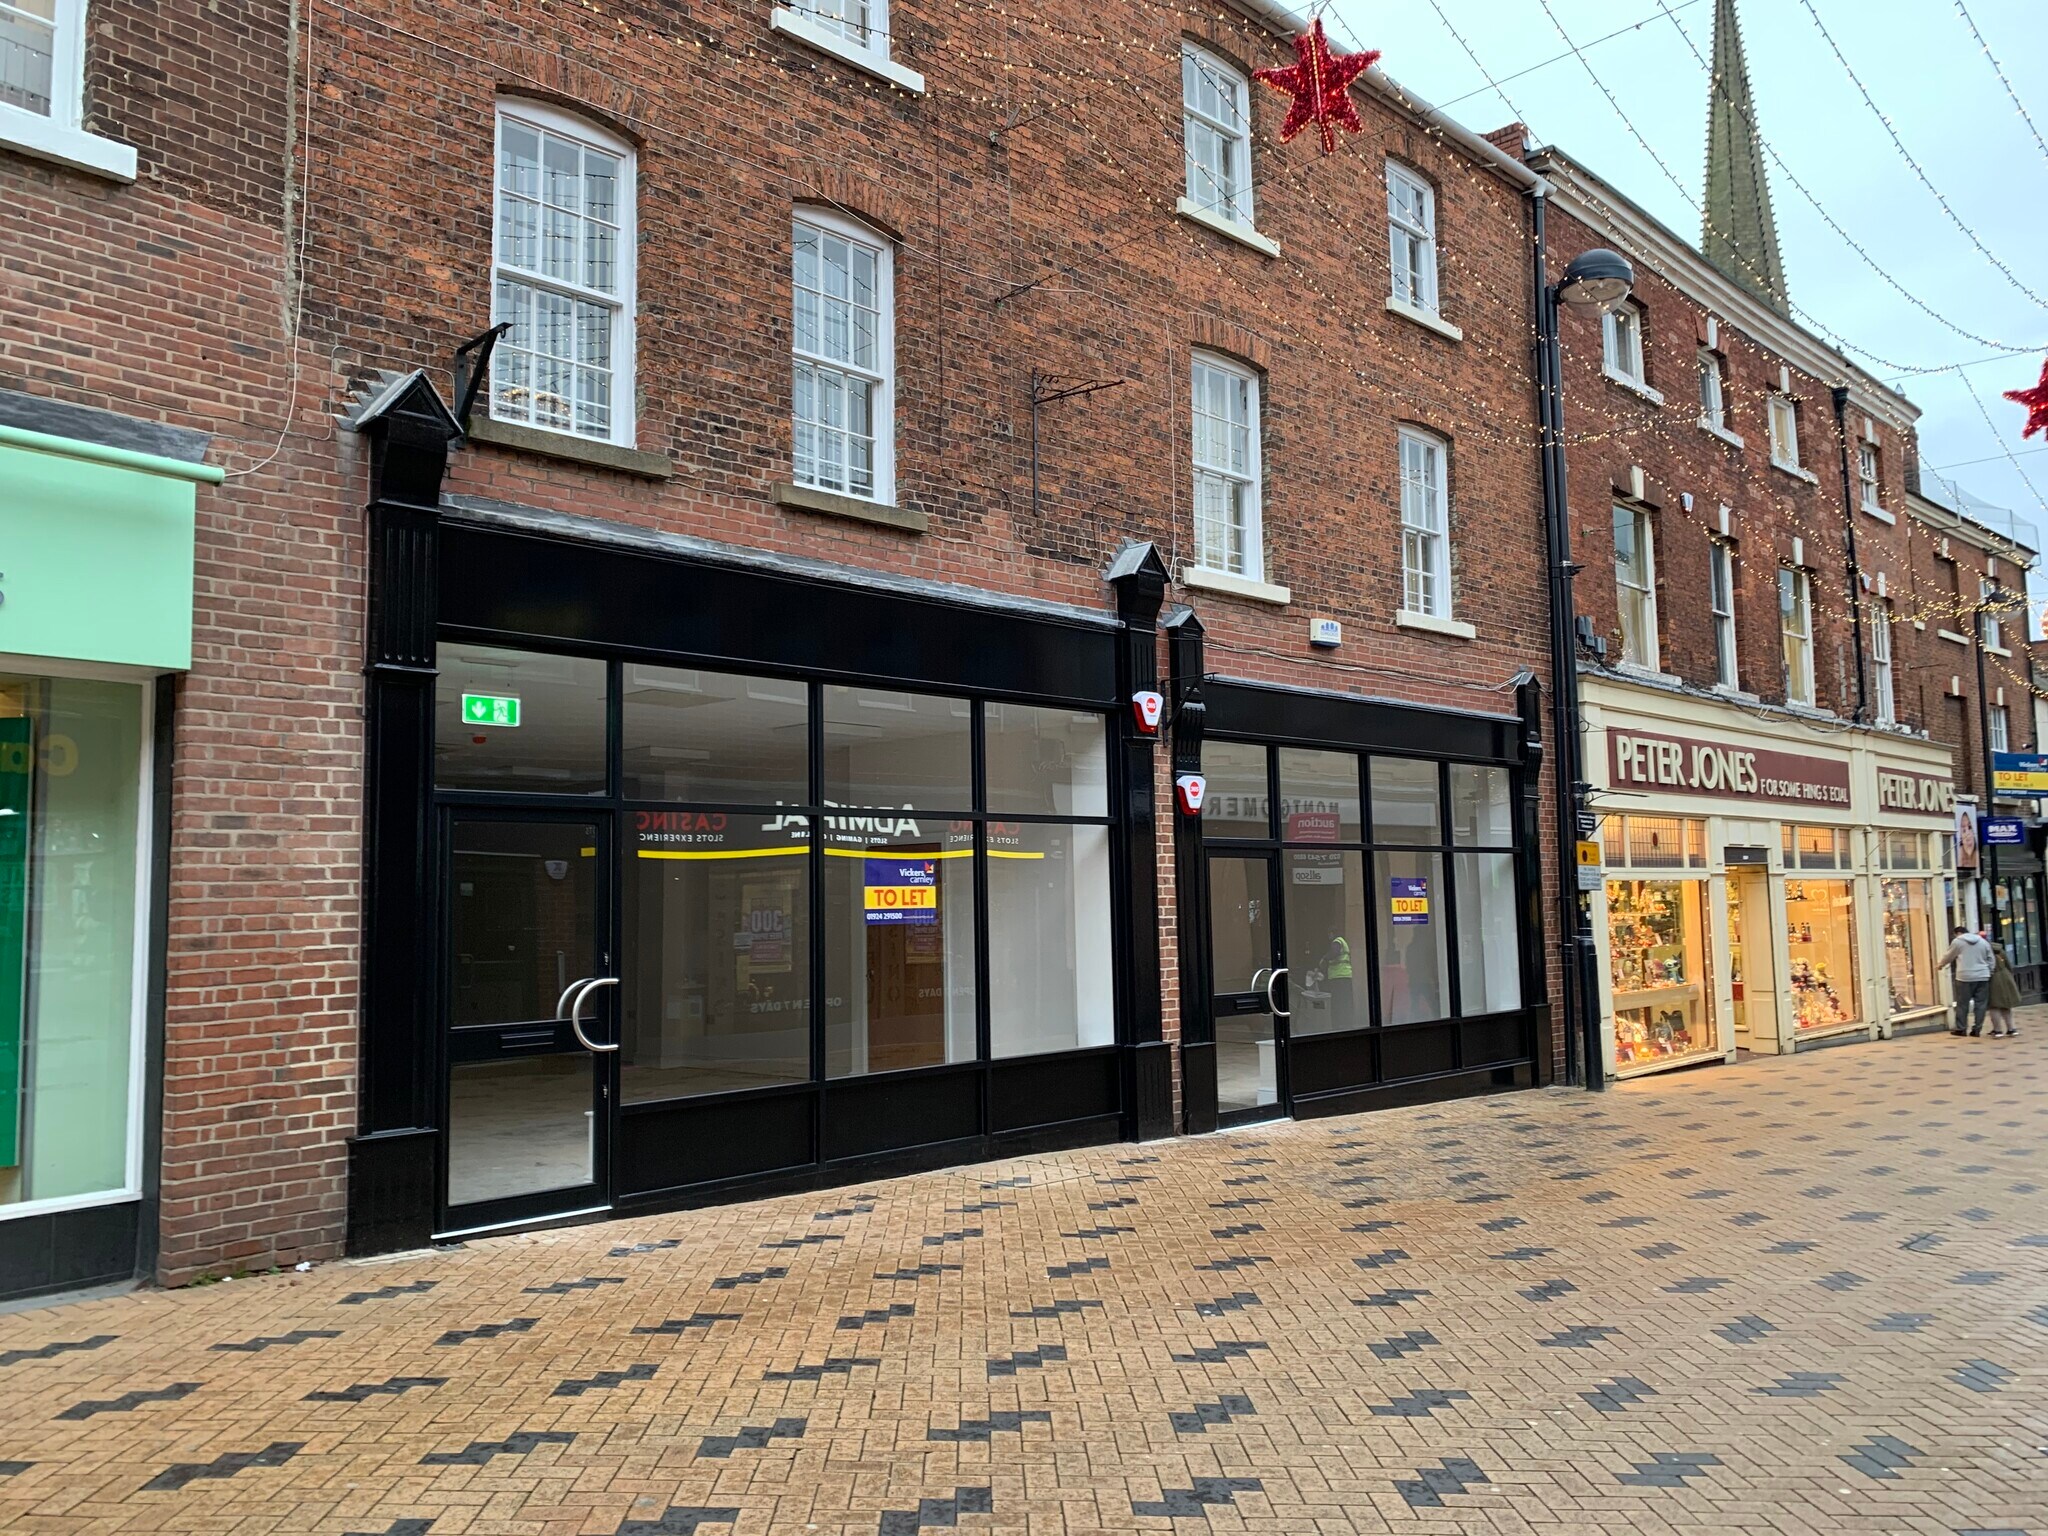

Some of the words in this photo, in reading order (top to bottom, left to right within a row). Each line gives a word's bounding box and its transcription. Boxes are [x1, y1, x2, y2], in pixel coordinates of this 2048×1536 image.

[1615, 734, 1686, 786] PETER
[1689, 745, 1758, 794] JONES
[1998, 772, 2011, 781] TO
[2014, 772, 2028, 782] LET
[1760, 778, 1779, 796] FOR
[1879, 772, 1918, 809] PETER
[1918, 778, 1956, 813] JONES
[1987, 824, 2018, 833] MAX
[899, 868, 925, 877] Vickers
[873, 889, 898, 907] TO
[901, 889, 927, 906] LET
[1396, 900, 1408, 912] TO
[1410, 900, 1423, 912] LET
